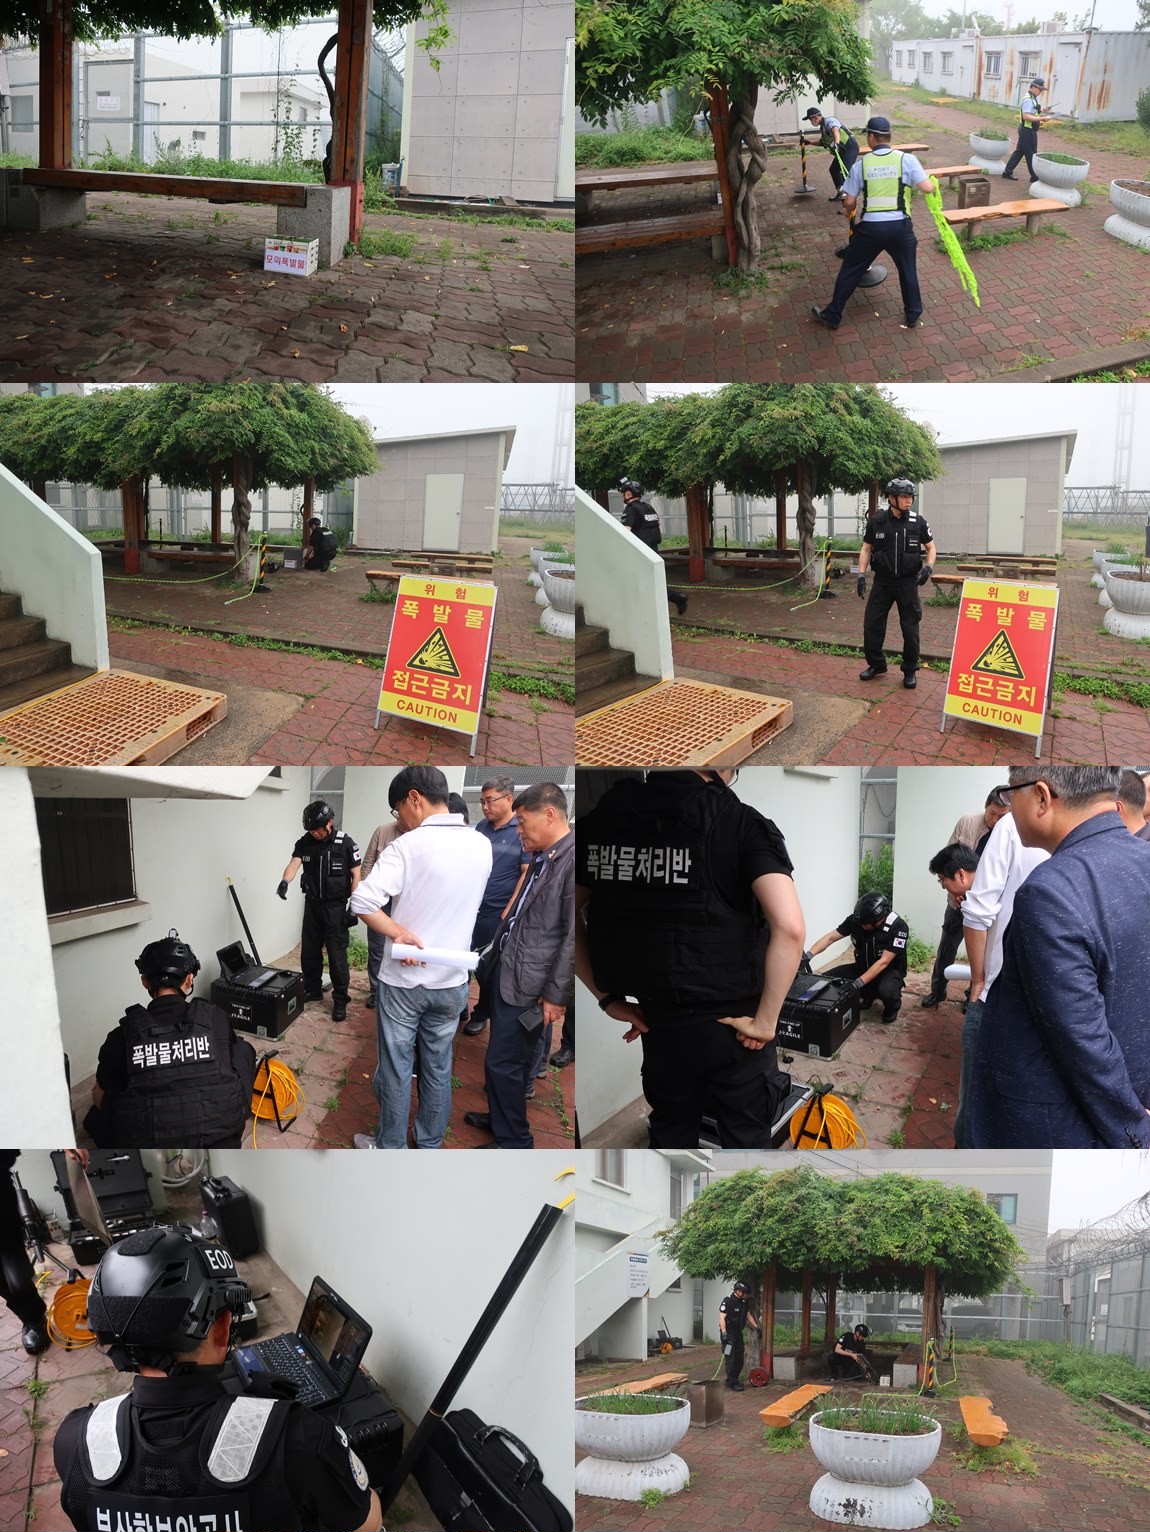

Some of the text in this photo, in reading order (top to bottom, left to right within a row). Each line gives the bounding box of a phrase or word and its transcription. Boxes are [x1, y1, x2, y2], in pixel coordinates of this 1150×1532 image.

[266, 254, 305, 269] 모의폭발물
[392, 669, 472, 705] 접근금지
[957, 673, 1037, 707] 접근금지
[396, 699, 458, 723] CAUTION
[962, 702, 1023, 725] CAUTION
[587, 844, 692, 885] 폭발물처리반
[132, 1036, 210, 1069] 폭발물처리반
[204, 1249, 234, 1270] EOD
